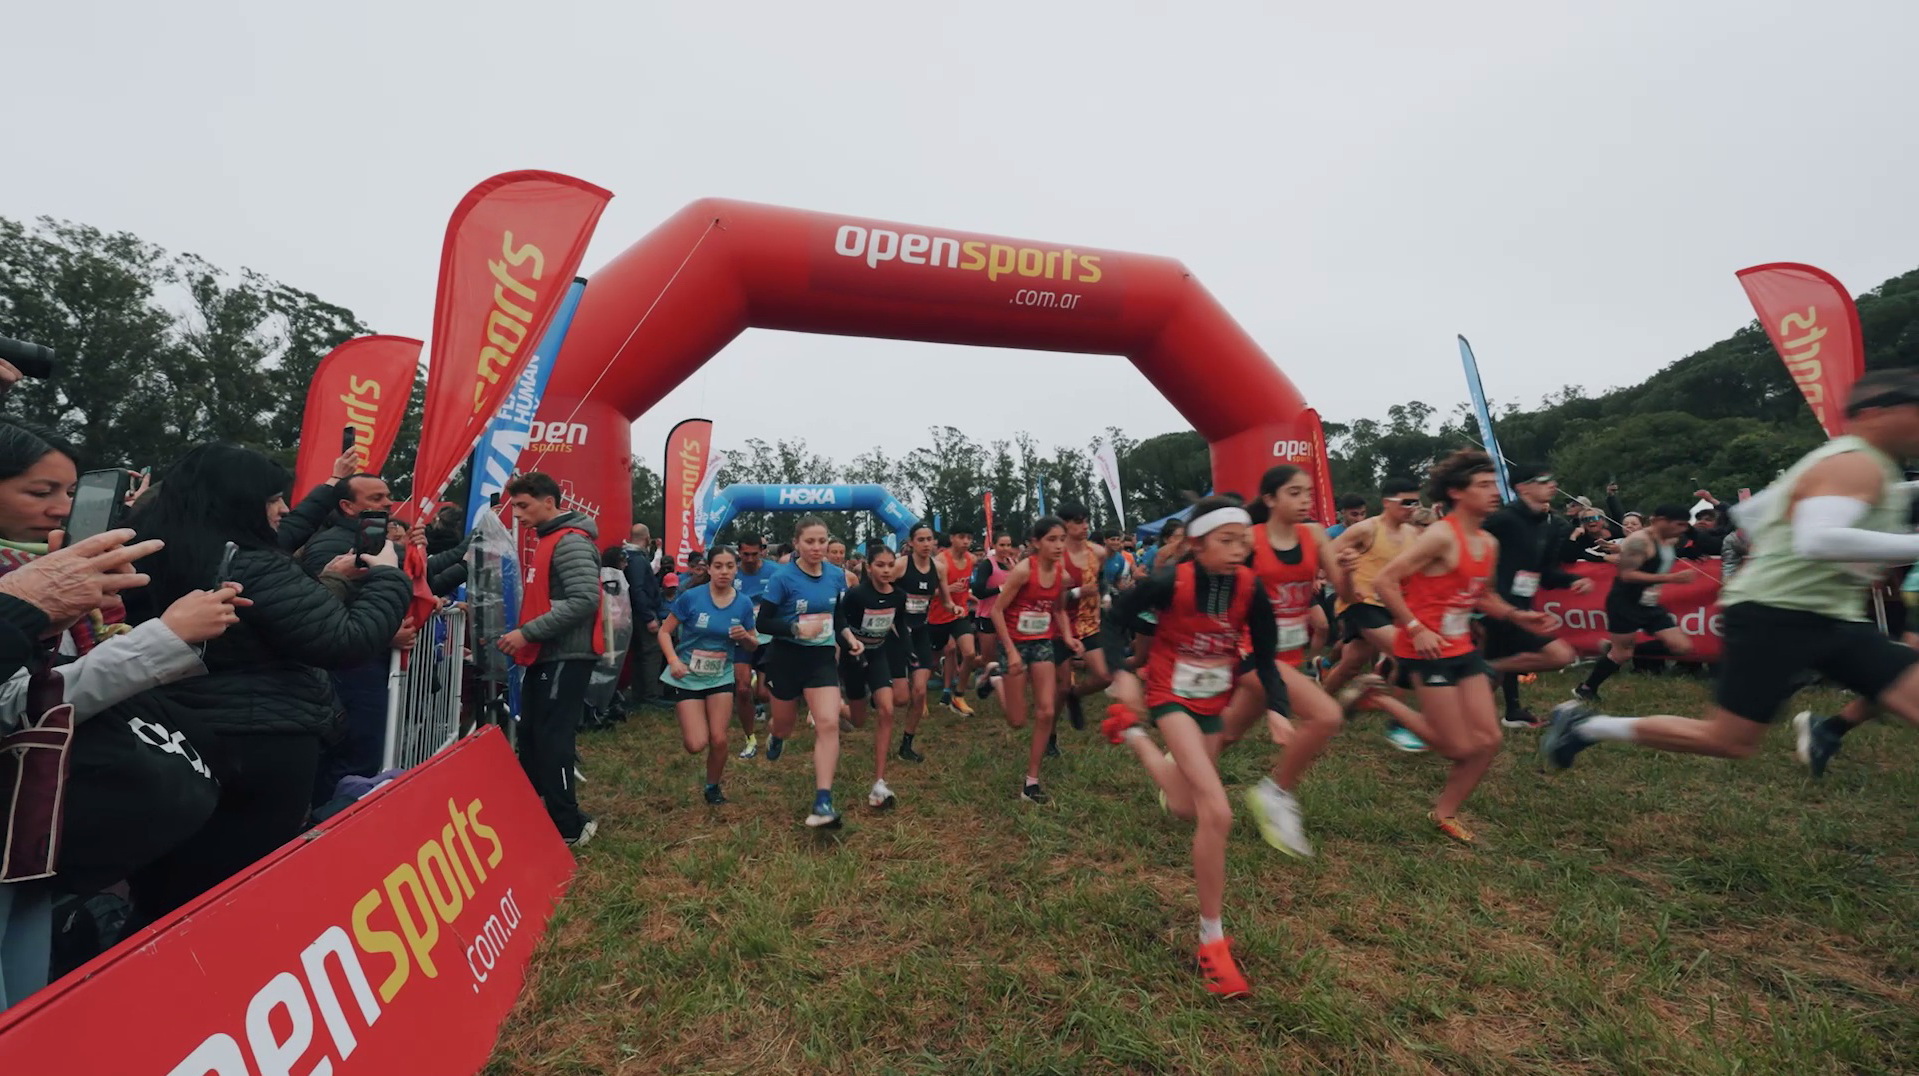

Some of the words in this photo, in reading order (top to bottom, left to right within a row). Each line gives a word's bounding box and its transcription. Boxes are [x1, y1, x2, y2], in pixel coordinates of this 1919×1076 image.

[834, 224, 1102, 283] opensports
[1009, 288, 1081, 310] .com.ar
[530, 442, 573, 453] sports
[779, 487, 837, 505] HOKA
[465, 887, 522, 994] .com.ar
